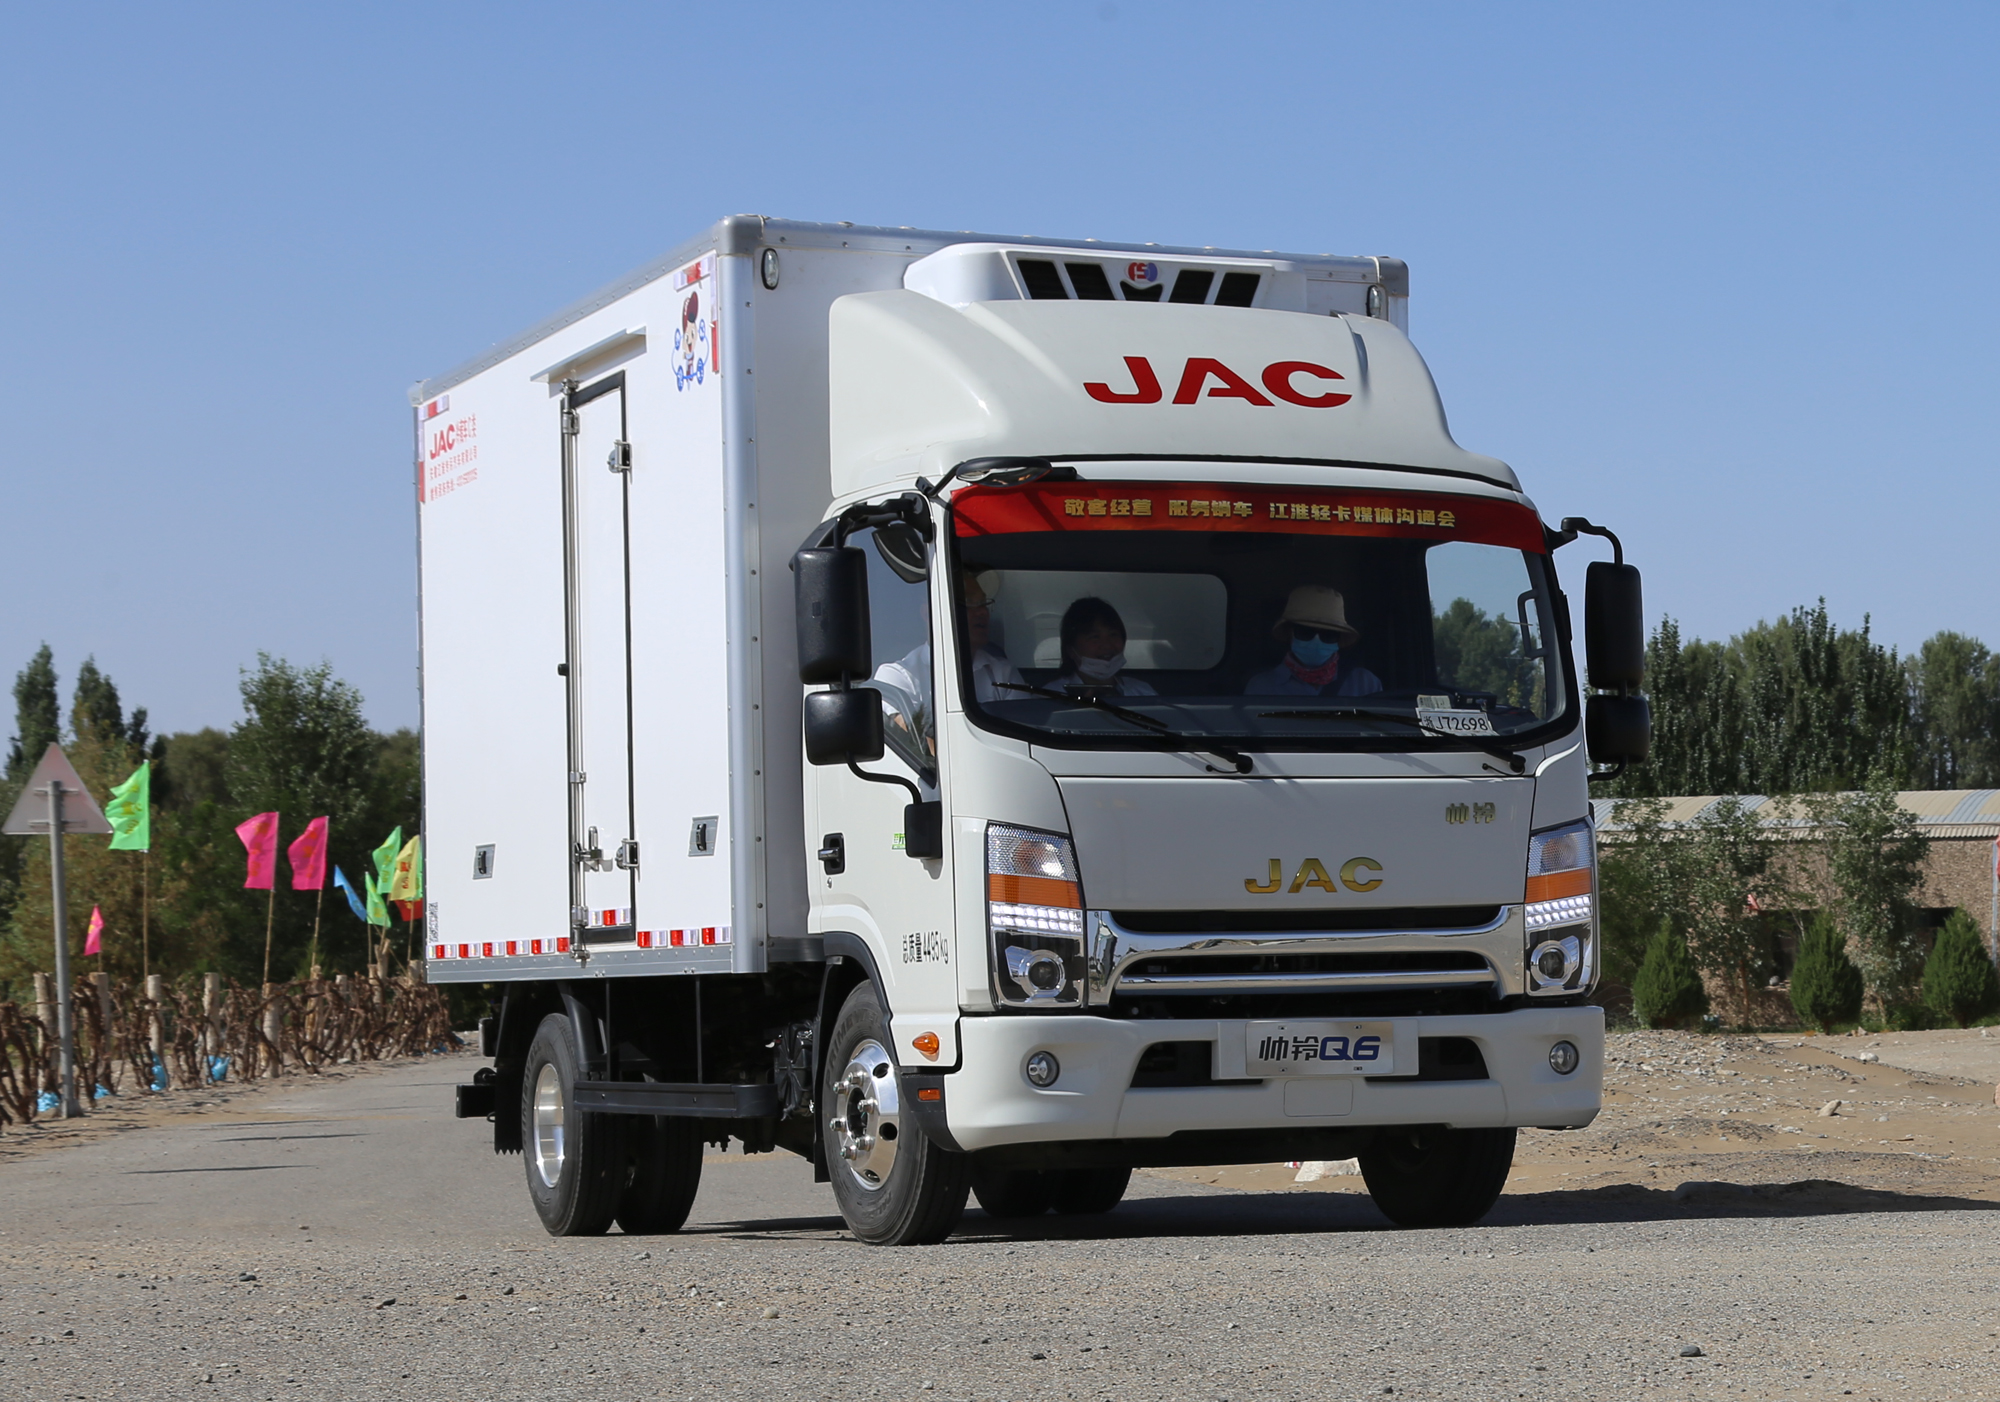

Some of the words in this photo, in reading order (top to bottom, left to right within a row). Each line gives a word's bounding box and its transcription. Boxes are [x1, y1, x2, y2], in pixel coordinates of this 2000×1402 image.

[1083, 355, 1353, 409] JAC
[429, 423, 456, 460] JAC
[1064, 498, 1152, 517] 敬客经营
[1168, 499, 1253, 518] 服务销车
[1269, 502, 1456, 528] 江淮轻卡媒体沟通会
[1445, 801, 1496, 824] 帅铃
[1244, 856, 1384, 894] JAC
